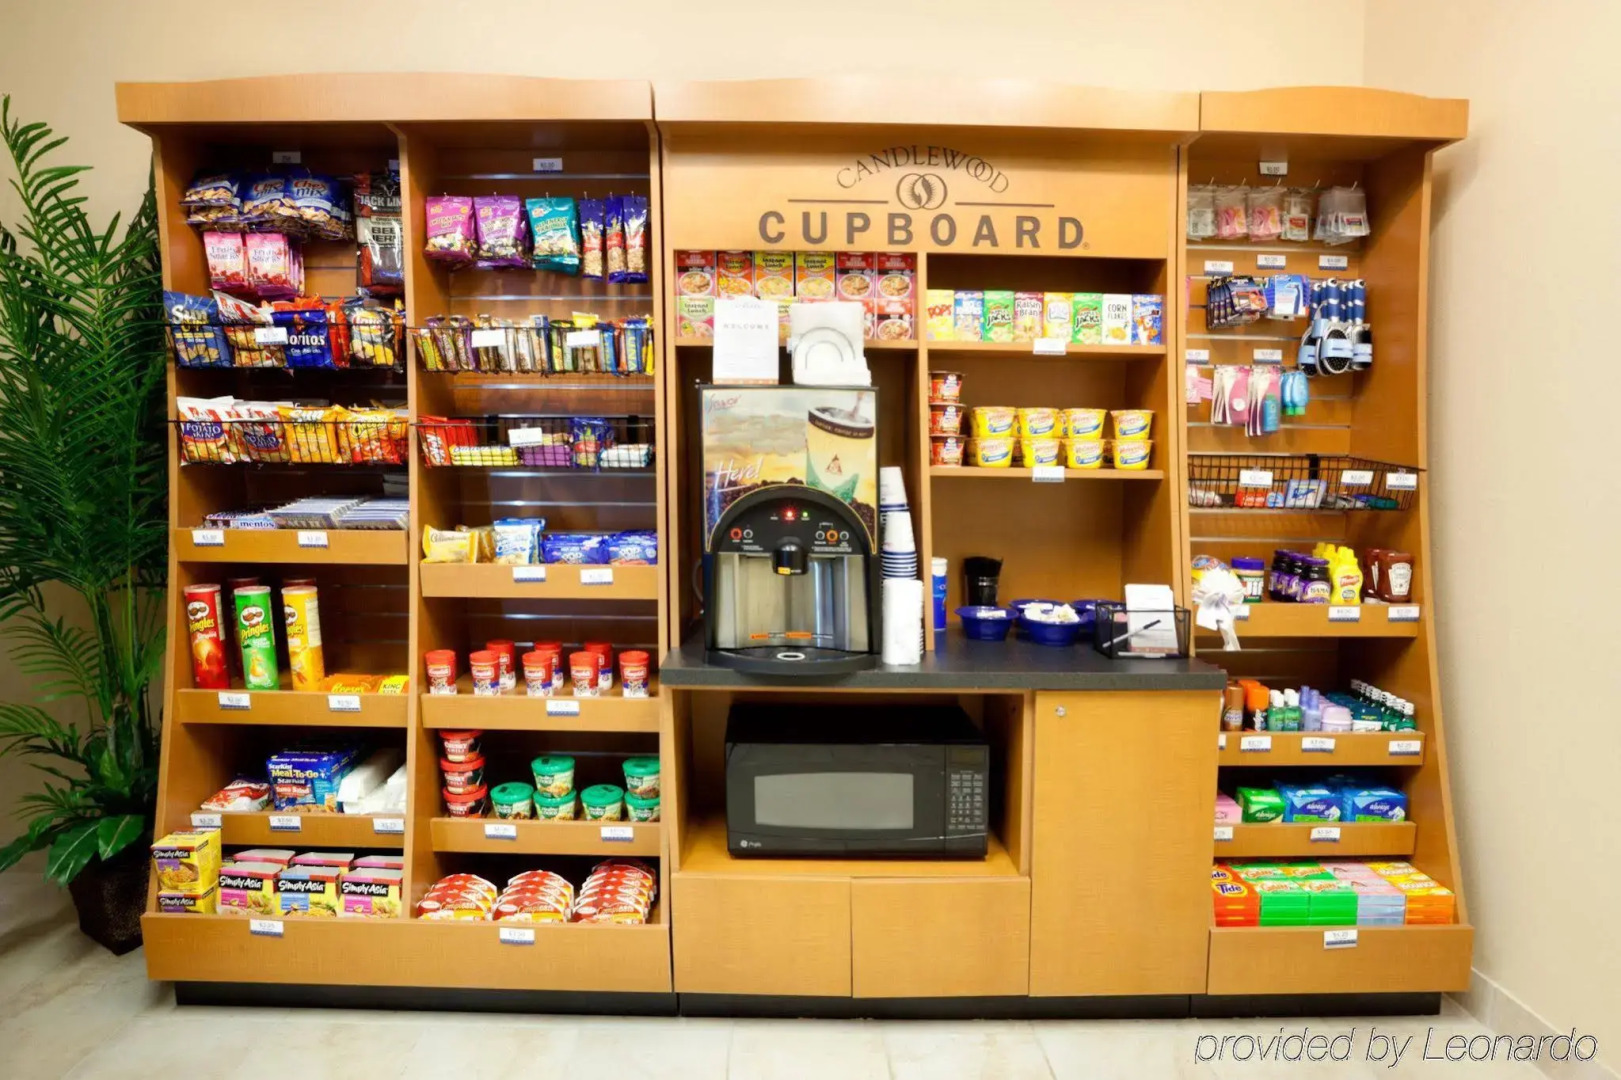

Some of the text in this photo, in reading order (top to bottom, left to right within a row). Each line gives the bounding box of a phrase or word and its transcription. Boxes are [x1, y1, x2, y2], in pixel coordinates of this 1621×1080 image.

[836, 145, 1009, 194] CANDLEWOOD
[758, 210, 1084, 249] CUPBOARD
[1107, 303, 1127, 312] CORN
[714, 457, 763, 490] Here!
[239, 517, 275, 528] mentos
[241, 623, 270, 642] Pringles
[271, 769, 319, 779] Meal-To-Go
[219, 876, 262, 889] Simply Asia
[278, 880, 325, 891] Simply Asia
[342, 883, 388, 894] Simply Asia
[1215, 883, 1243, 894] Tide
